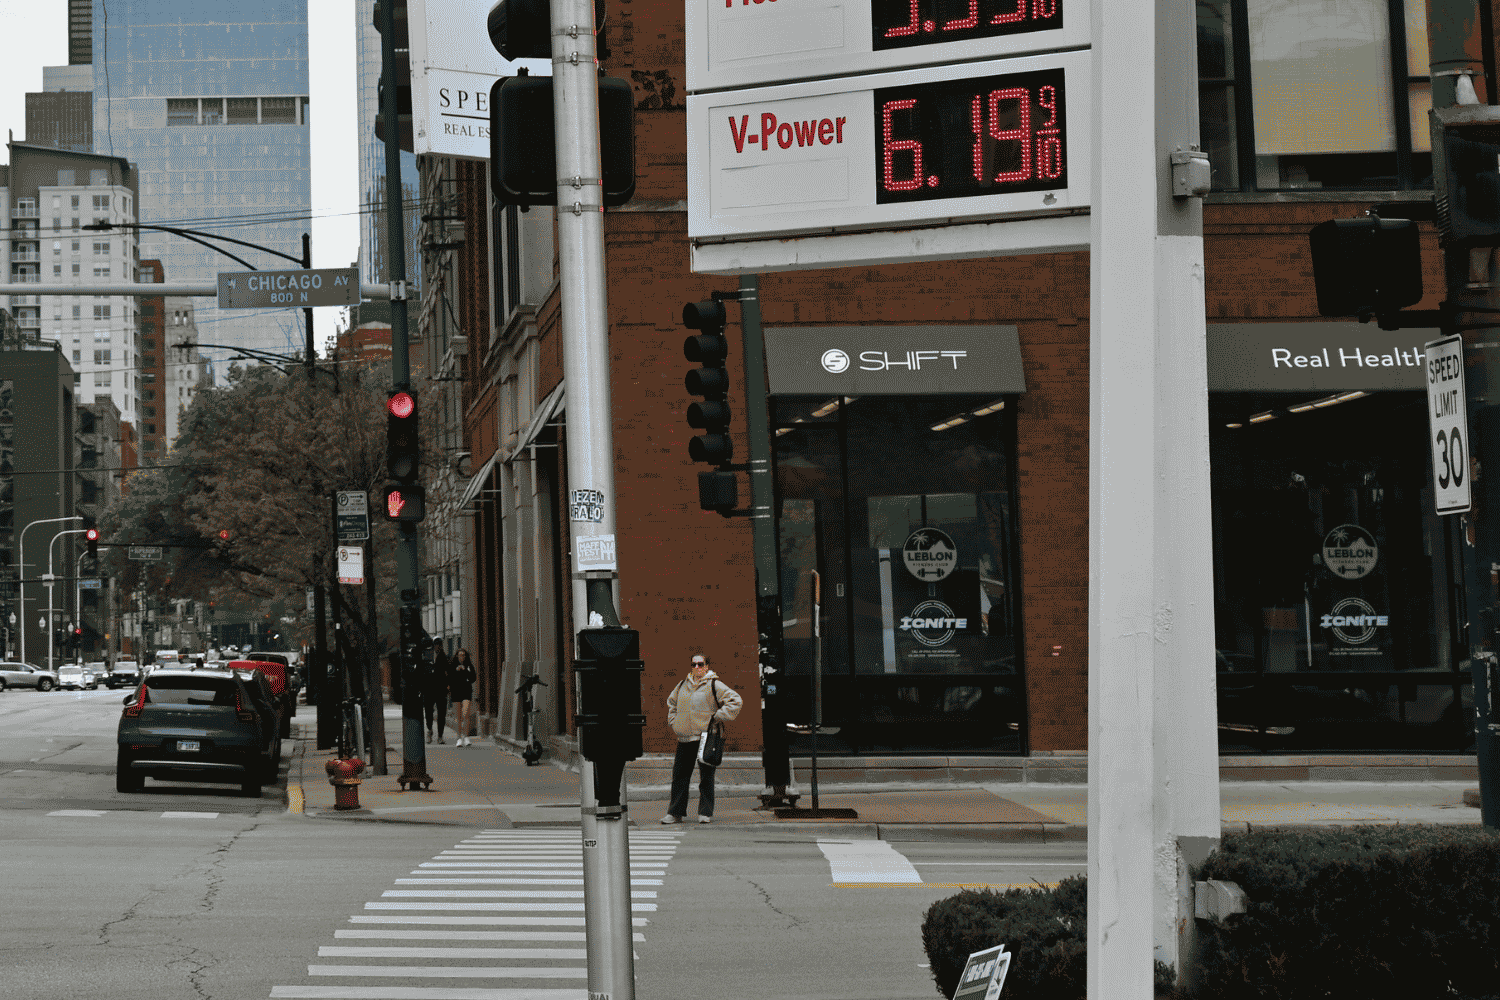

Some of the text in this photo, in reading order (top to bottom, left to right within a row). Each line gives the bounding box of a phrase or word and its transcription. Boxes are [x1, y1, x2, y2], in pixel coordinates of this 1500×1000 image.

[444, 122, 475, 137] REAL
[728, 113, 846, 153] V-Power
[883, 87, 1031, 191] 6.19
[247, 274, 322, 291] CHICAGO
[333, 275, 349, 287] AV
[270, 291, 308, 304] 800 N
[859, 350, 968, 371] SHIFT
[1271, 347, 1330, 368] Real
[1430, 353, 1460, 384] SPEED
[1434, 389, 1458, 418] LIMIT
[1436, 426, 1464, 490] 30
[907, 551, 953, 561] LEBLON
[1328, 548, 1373, 558] LEBLON
